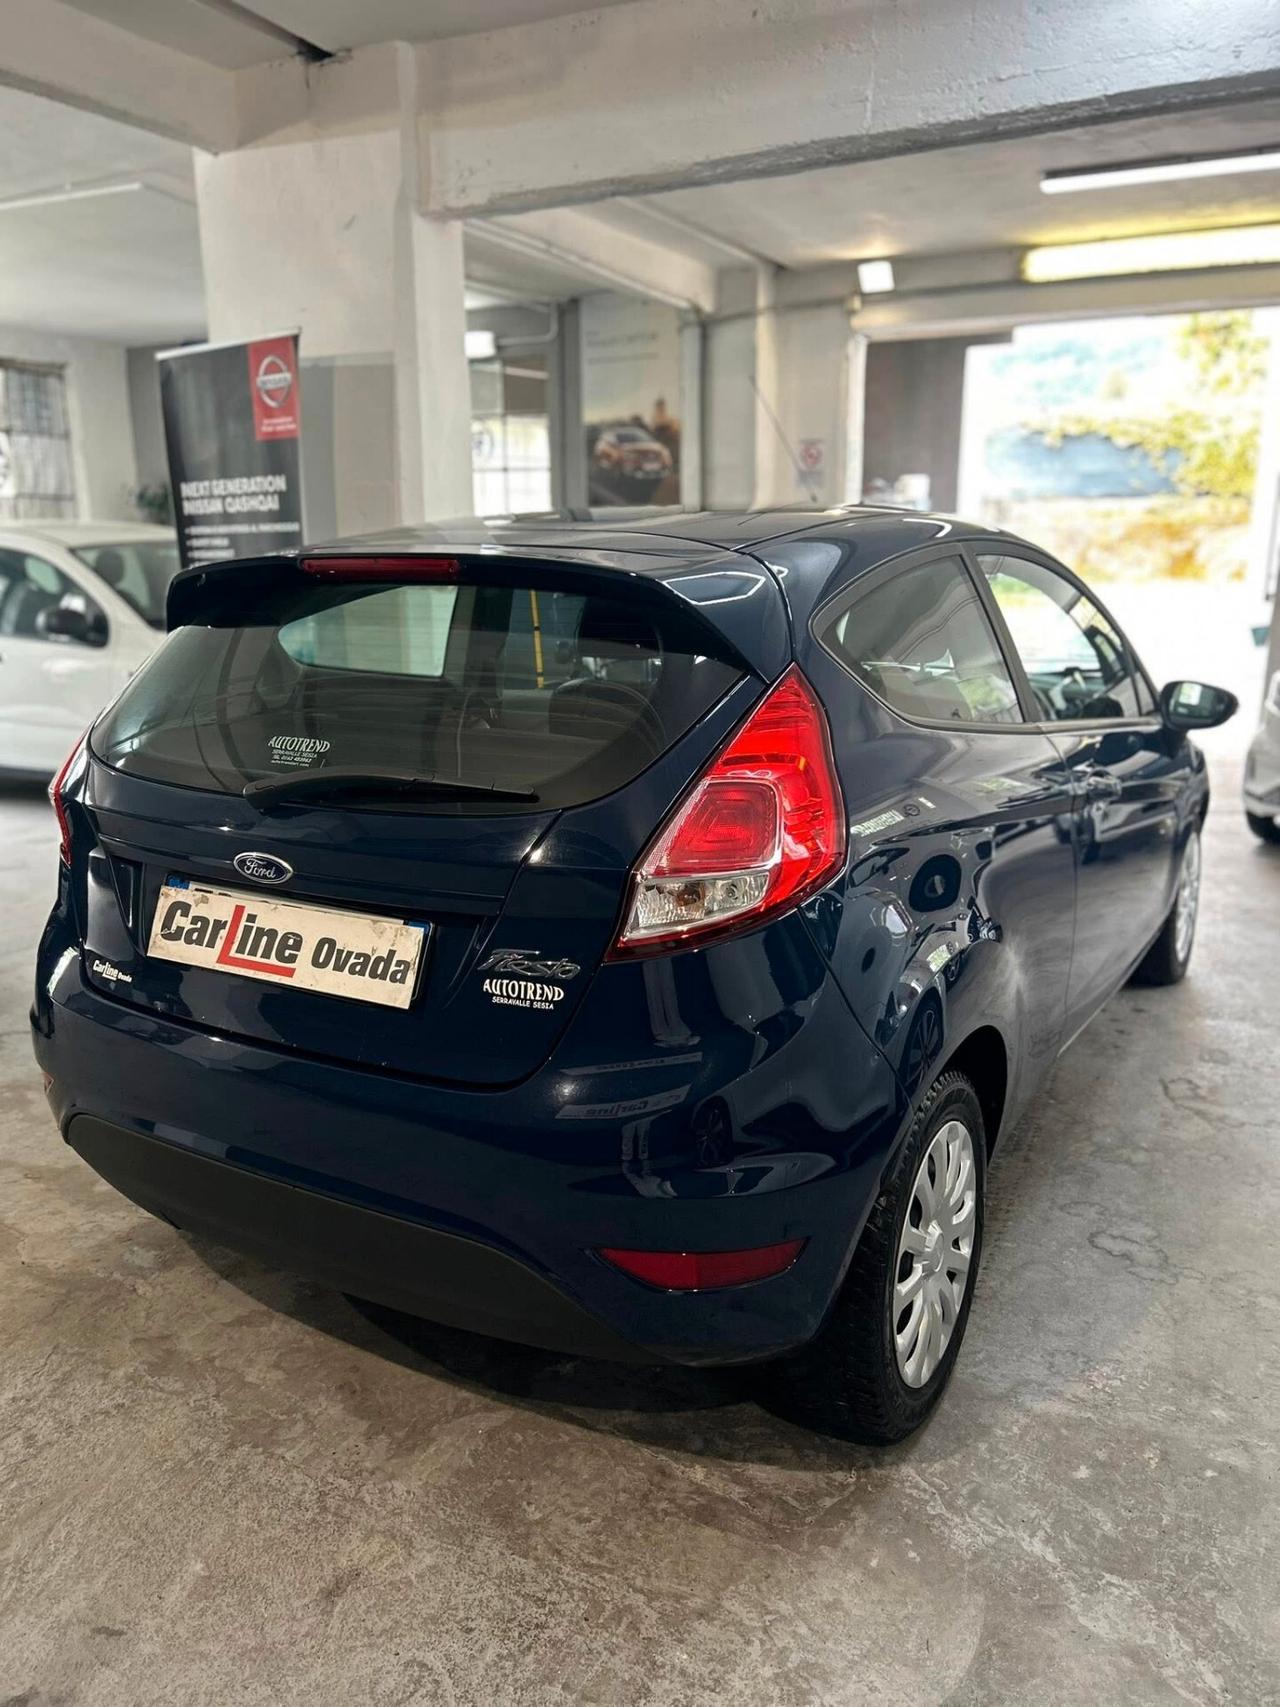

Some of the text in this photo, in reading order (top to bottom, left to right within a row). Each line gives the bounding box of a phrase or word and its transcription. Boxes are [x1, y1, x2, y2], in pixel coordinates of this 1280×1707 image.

[181, 474, 287, 498] NEXT GENERATION
[182, 493, 280, 516] NISSAN QASHQAI
[267, 736, 331, 753] AUTOTREND
[243, 858, 277, 879] Ford
[160, 900, 411, 985] CarLine Ovada
[477, 948, 581, 980] Fiesta
[483, 979, 565, 1002] AUTOTREND
[491, 996, 554, 1010] SERRAVALLE SESIA
